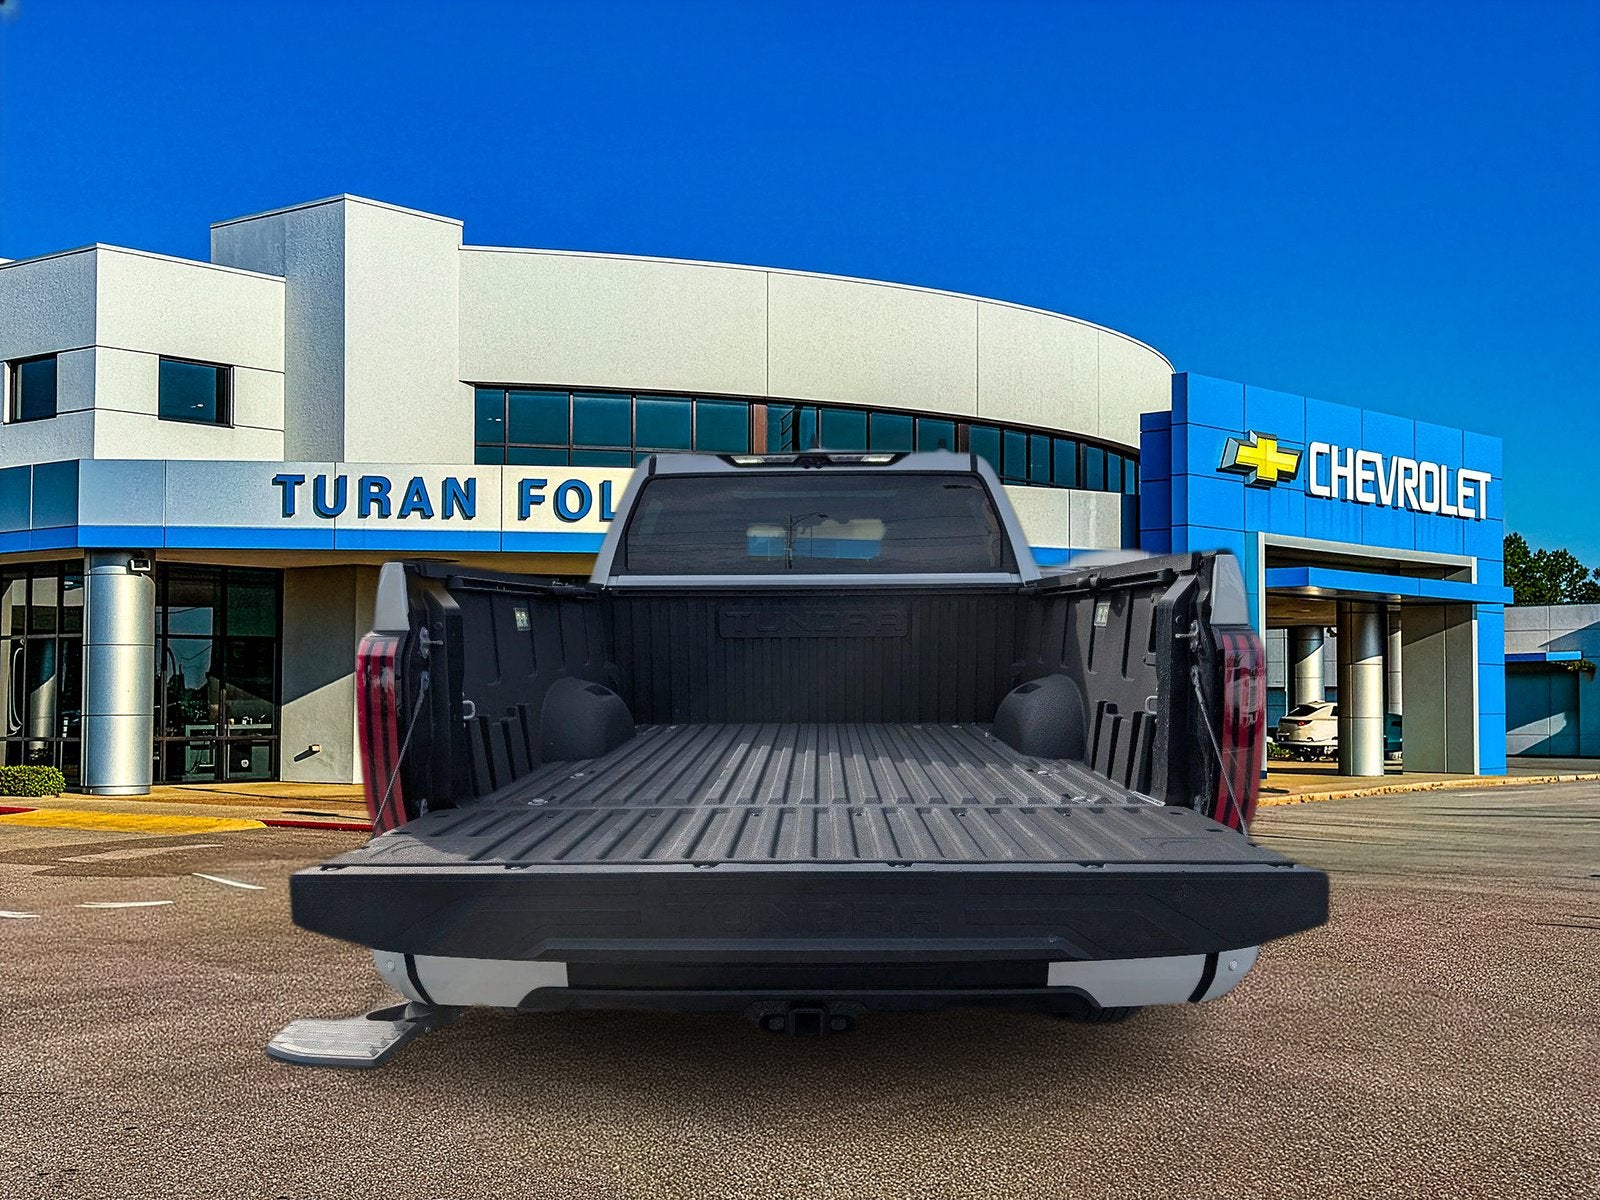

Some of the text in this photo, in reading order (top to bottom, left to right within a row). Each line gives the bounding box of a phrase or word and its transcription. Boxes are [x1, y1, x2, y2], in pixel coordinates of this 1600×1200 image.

[272, 473, 616, 522] TURAN FOL
[1305, 441, 1492, 521] CHEVROLET
[725, 610, 903, 633] TUNDRA
